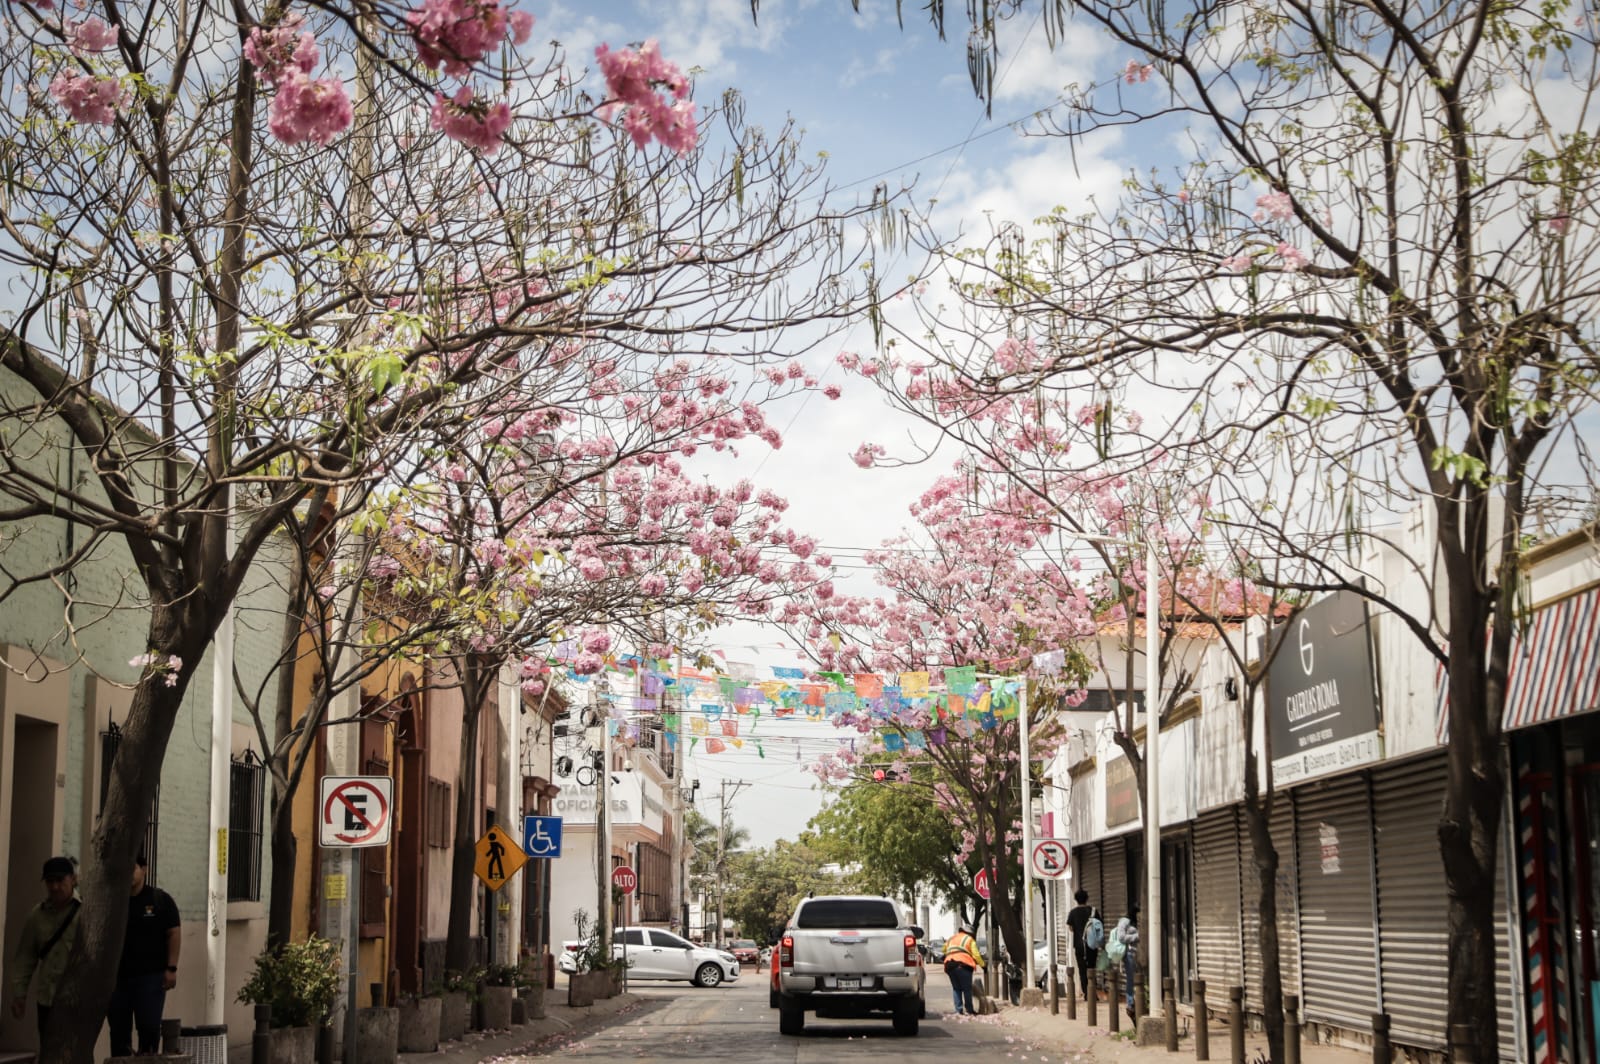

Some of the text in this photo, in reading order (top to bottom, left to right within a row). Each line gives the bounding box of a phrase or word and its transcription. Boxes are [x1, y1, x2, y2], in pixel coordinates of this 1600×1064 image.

[1287, 679, 1340, 722] GALERIAS ROMA
[344, 794, 368, 831] E
[557, 799, 628, 812] OFICIES
[1043, 848, 1058, 869] E
[614, 874, 634, 887] ALTO
[978, 876, 989, 889] AL
